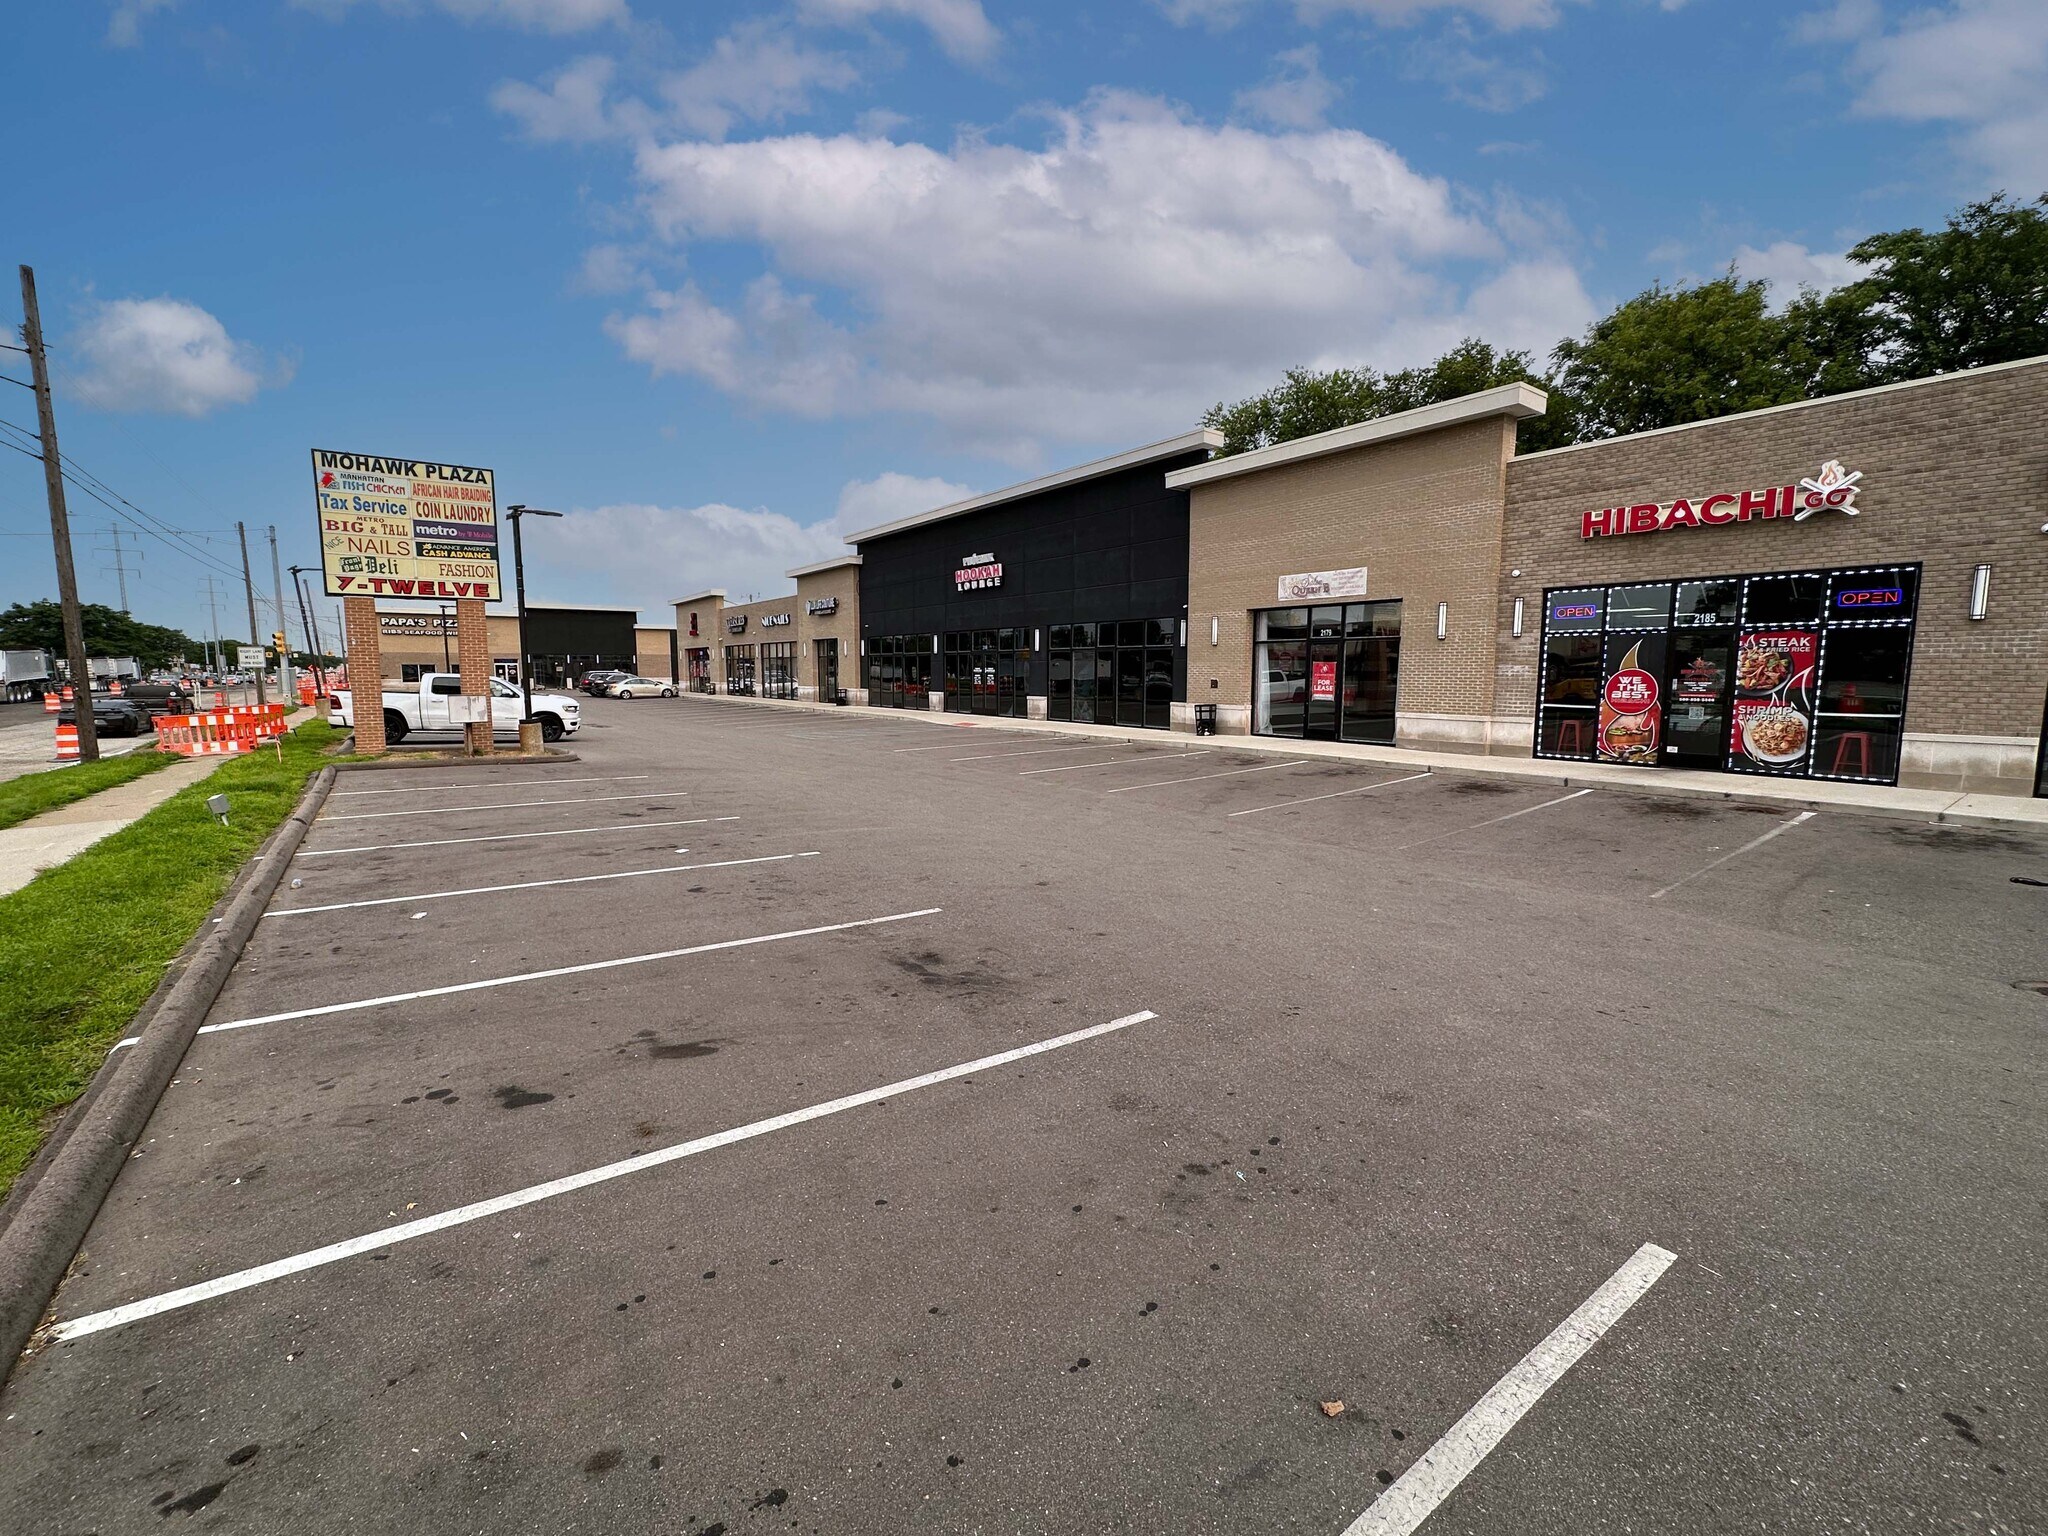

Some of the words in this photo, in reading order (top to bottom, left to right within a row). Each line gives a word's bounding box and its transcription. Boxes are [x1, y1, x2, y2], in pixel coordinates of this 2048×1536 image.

[320, 452, 418, 478] MOHAWK
[425, 464, 487, 484] PLAZA
[340, 473, 384, 483] MANHATTAN
[343, 481, 365, 491] FISH
[412, 483, 441, 498] AFRICAN
[443, 486, 460, 500] HAIR
[461, 488, 492, 502] BRAIDING
[320, 493, 348, 510] Tax
[353, 496, 407, 515] Service
[416, 501, 442, 519] COIN
[443, 503, 491, 523] LAUNDRY
[1580, 485, 1797, 539] HIBACHI
[1804, 487, 1852, 508] GO
[325, 519, 363, 533] BIG
[370, 526, 377, 534] &
[381, 524, 408, 536] TALL
[416, 526, 457, 536] metro
[324, 536, 344, 550] NICE
[348, 537, 410, 556] NAILS
[422, 549, 448, 557] CASH
[450, 551, 492, 559] ADVANCE
[364, 556, 399, 574] Deli
[439, 563, 495, 578] FASHION
[955, 563, 1002, 583] HOOKAH
[335, 576, 490, 598] 7-TWELVE
[957, 577, 1001, 591] LOUNGE
[1842, 591, 1899, 605] OPEN
[1556, 607, 1594, 617] OPEN
[1694, 613, 1716, 623] 2185
[381, 617, 427, 627] PAPA'S
[1320, 629, 1332, 637] 2179
[1758, 637, 1811, 647] STEAK
[1618, 676, 1643, 684] WE
[1611, 691, 1652, 699] BEST
[1738, 705, 1794, 716] SHRIMP
[1744, 714, 1792, 722] NOODLES
